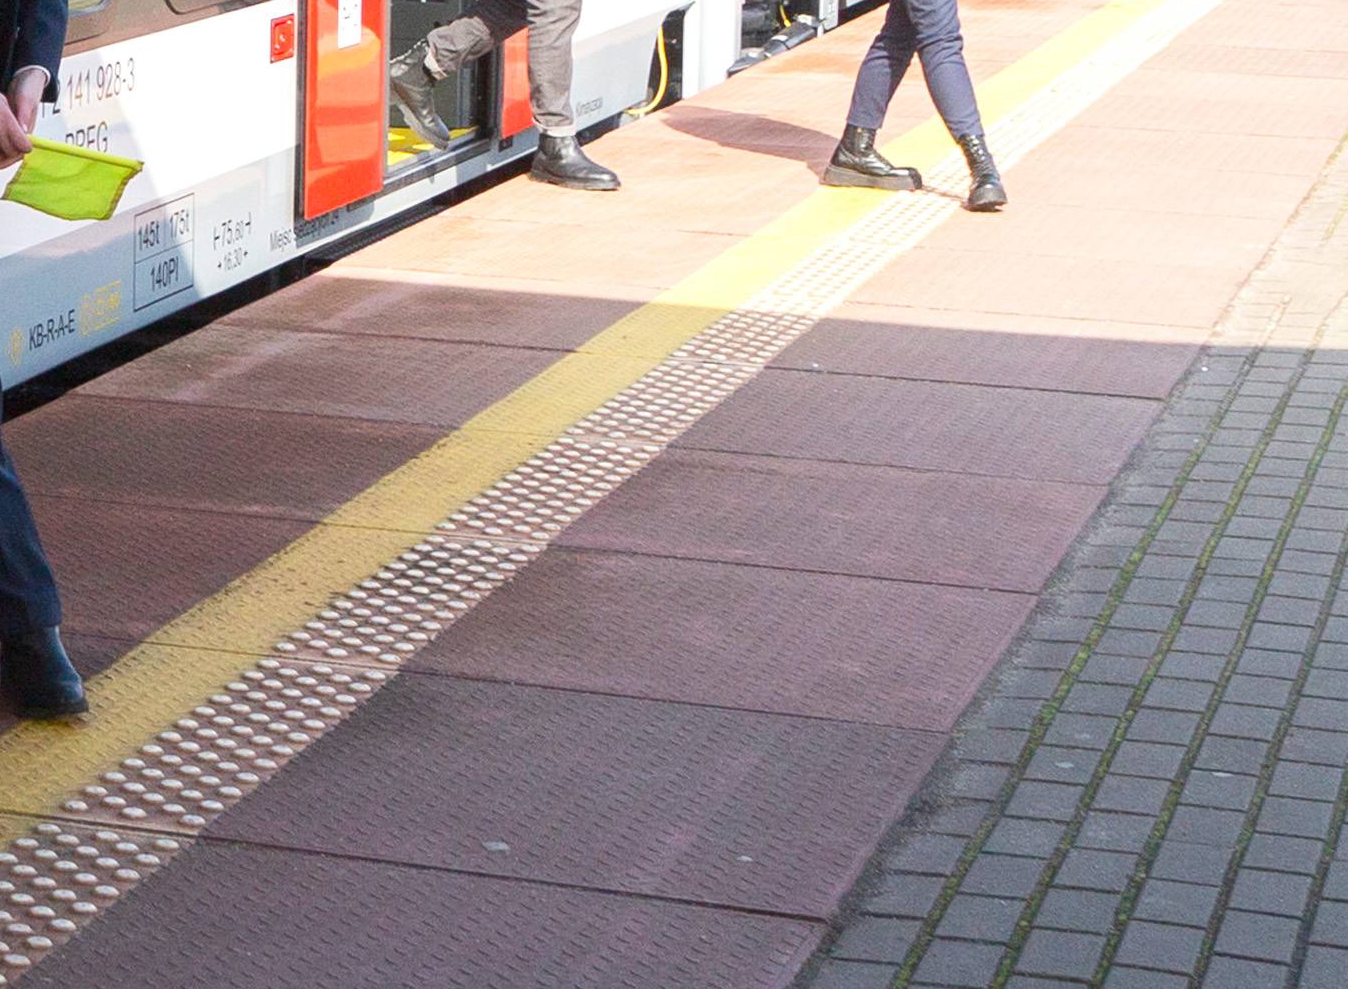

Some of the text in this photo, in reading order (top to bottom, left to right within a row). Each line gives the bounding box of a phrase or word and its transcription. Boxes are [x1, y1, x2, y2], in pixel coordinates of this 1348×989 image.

[67, 68, 91, 111] 141
[96, 57, 136, 102] 928-3
[138, 208, 191, 251] 145t 175t
[28, 309, 76, 351] KB-R-A-E
